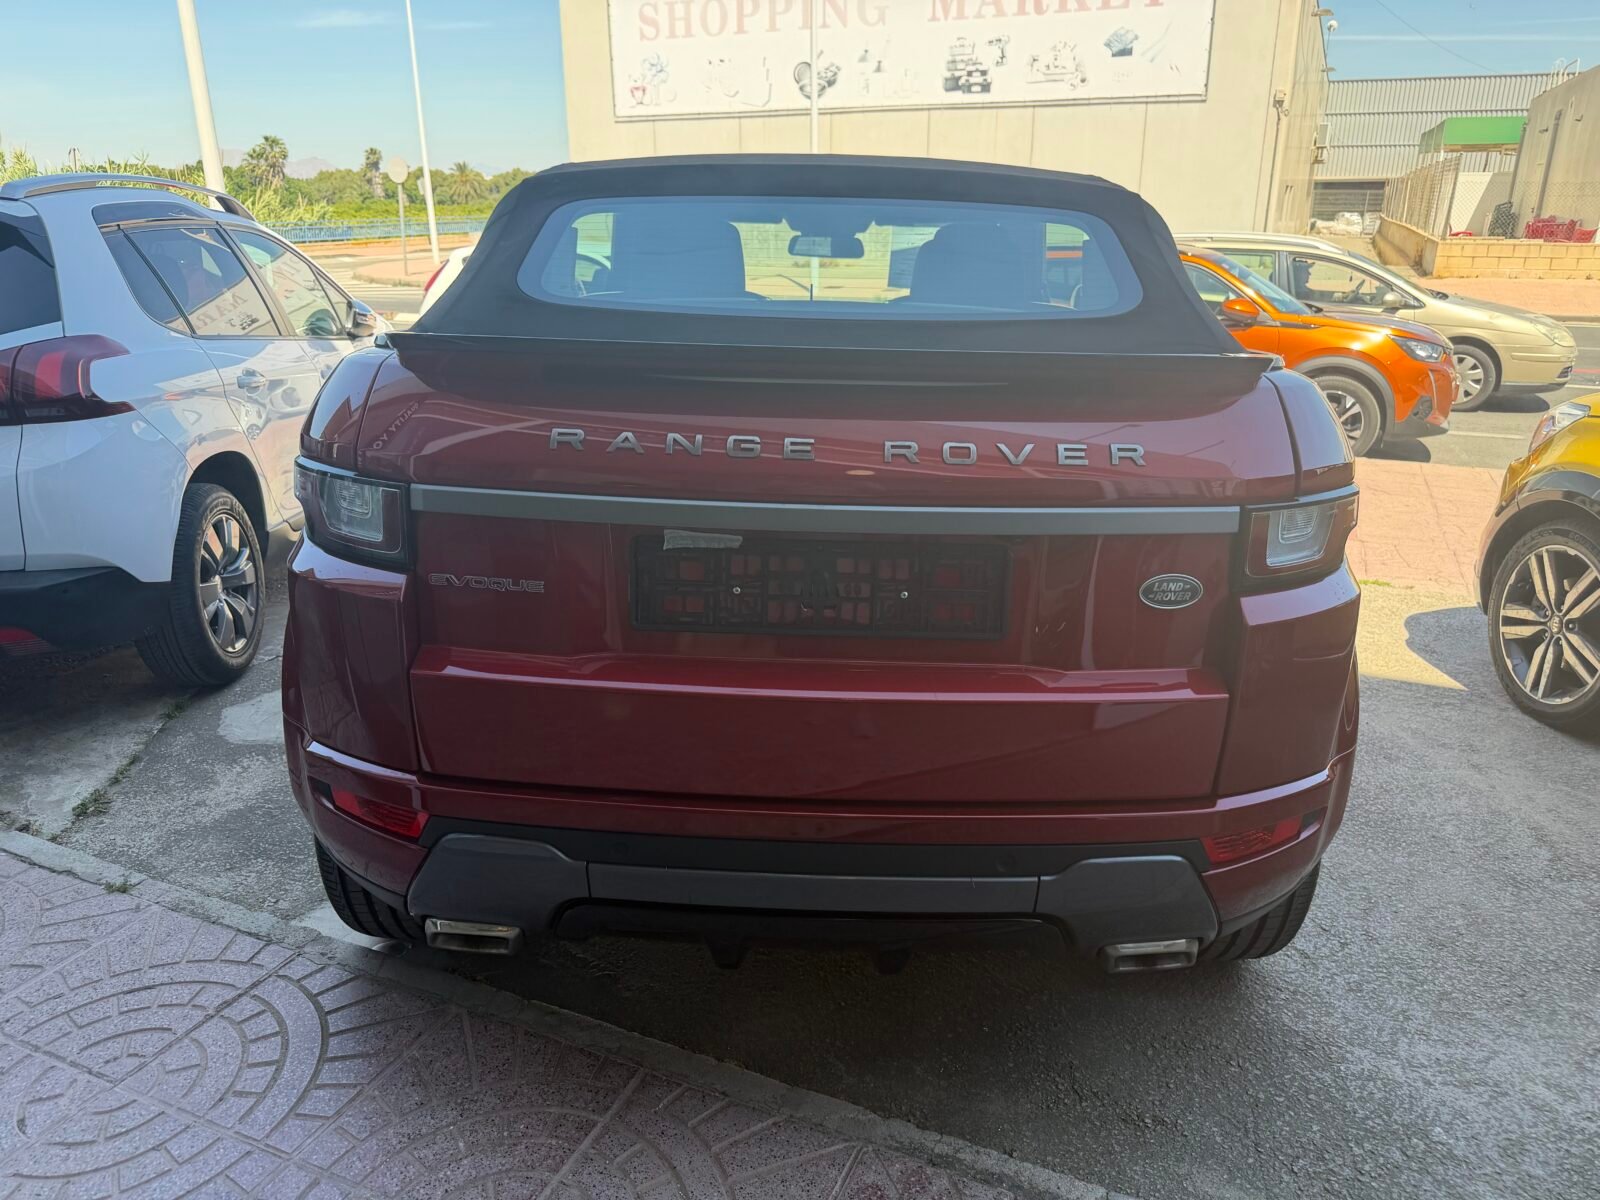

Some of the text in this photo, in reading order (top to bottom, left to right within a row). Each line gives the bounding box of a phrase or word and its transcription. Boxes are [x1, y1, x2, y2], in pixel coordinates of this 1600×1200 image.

[638, 0, 890, 42] SHOPPING
[550, 427, 1147, 466] RANGE ROVER
[428, 573, 545, 593] EVOQUE
[1153, 582, 1184, 592] LAND
[1154, 591, 1192, 601] ROVER
